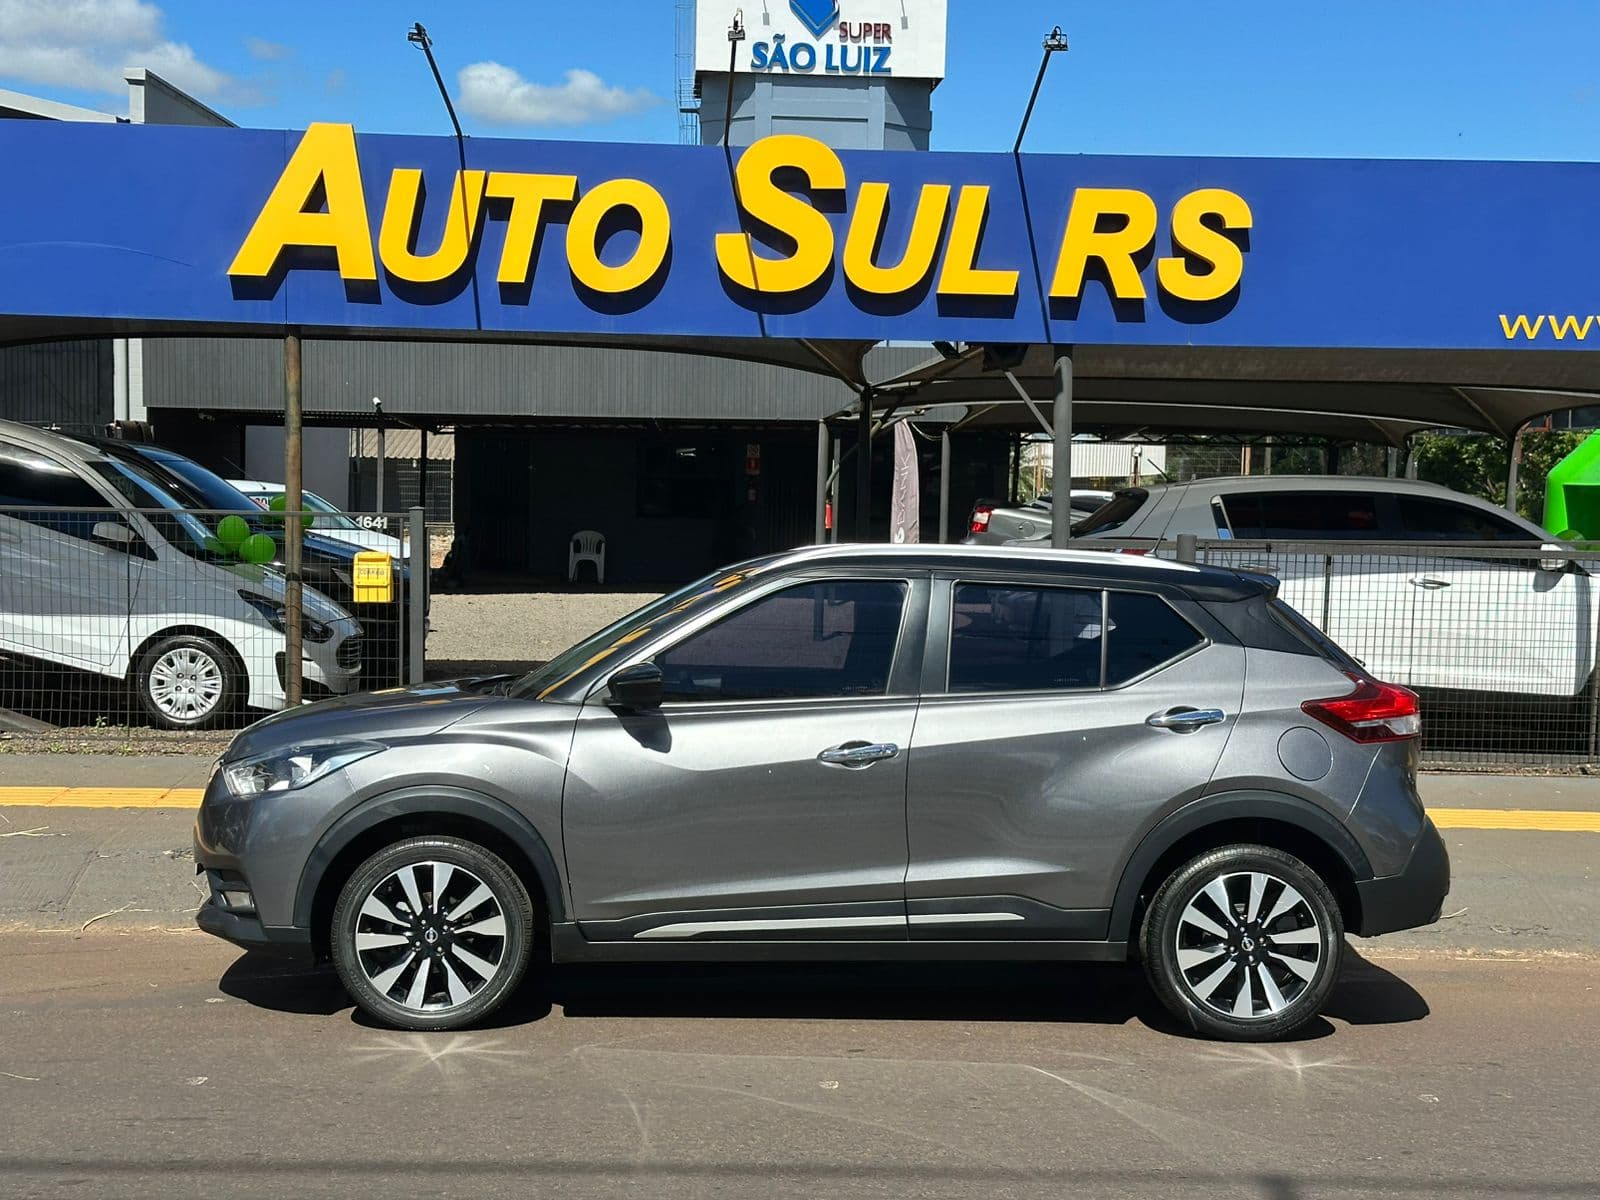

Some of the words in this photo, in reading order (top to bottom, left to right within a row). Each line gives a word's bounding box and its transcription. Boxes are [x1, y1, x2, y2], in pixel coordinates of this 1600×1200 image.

[839, 21, 892, 43] SUPER
[751, 34, 816, 72] SÃO
[825, 44, 892, 74] LUIZ
[226, 121, 671, 293] AUTO
[714, 134, 1020, 296] SUL
[1048, 187, 1253, 301] RS
[1498, 314, 1600, 340] ww
[355, 515, 388, 529] 1641
